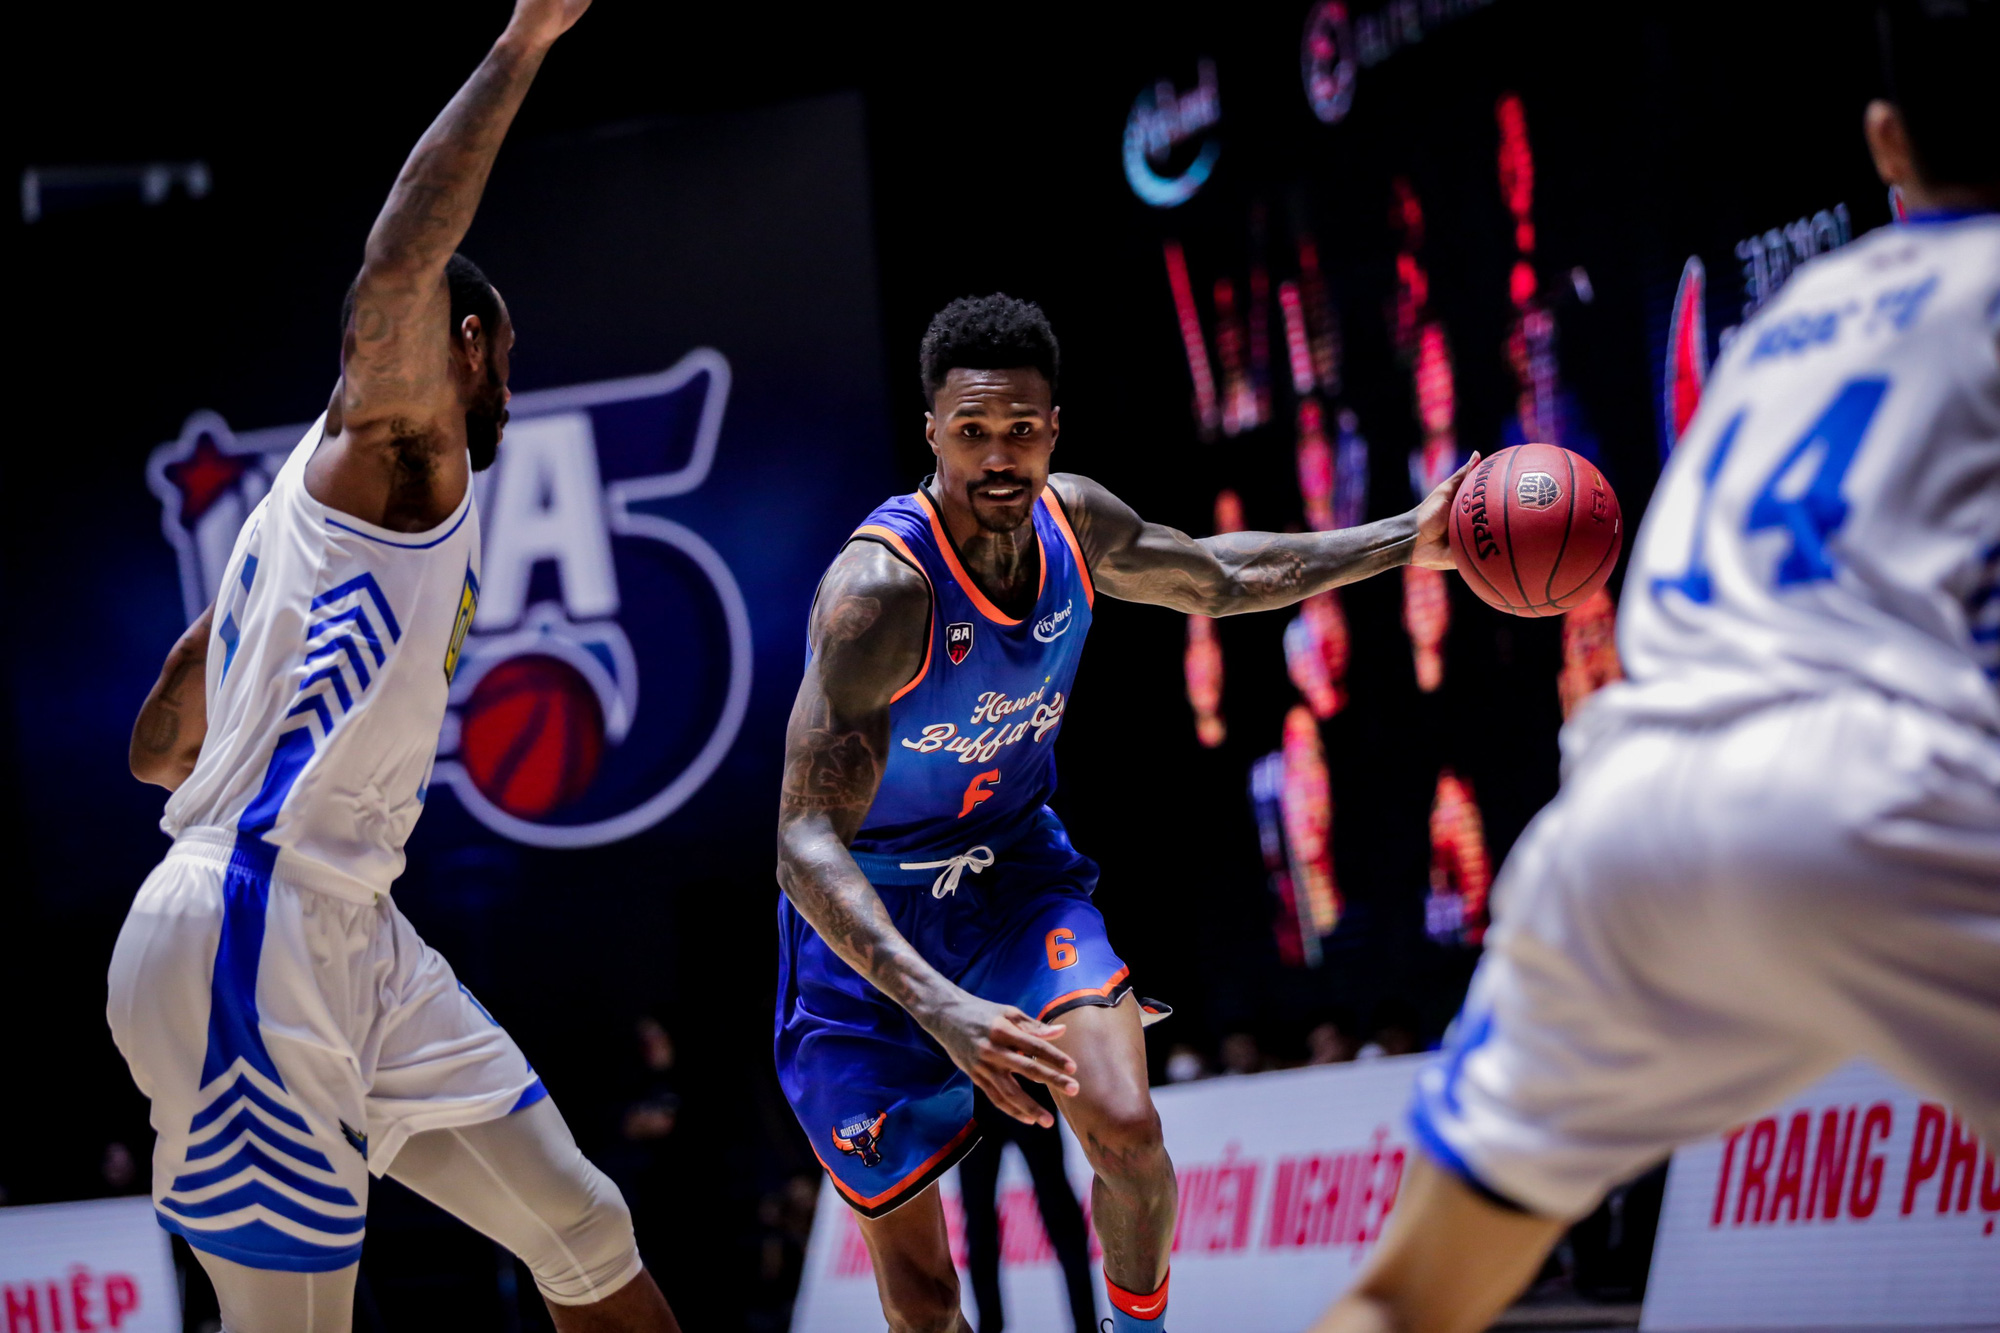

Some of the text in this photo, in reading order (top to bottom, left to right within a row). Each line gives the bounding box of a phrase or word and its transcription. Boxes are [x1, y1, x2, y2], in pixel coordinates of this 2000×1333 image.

[1519, 475, 1538, 504] VBA
[970, 676, 1050, 724] Hanoi
[1045, 927, 1078, 971] 6
[1711, 1100, 1893, 1227] TRANG
